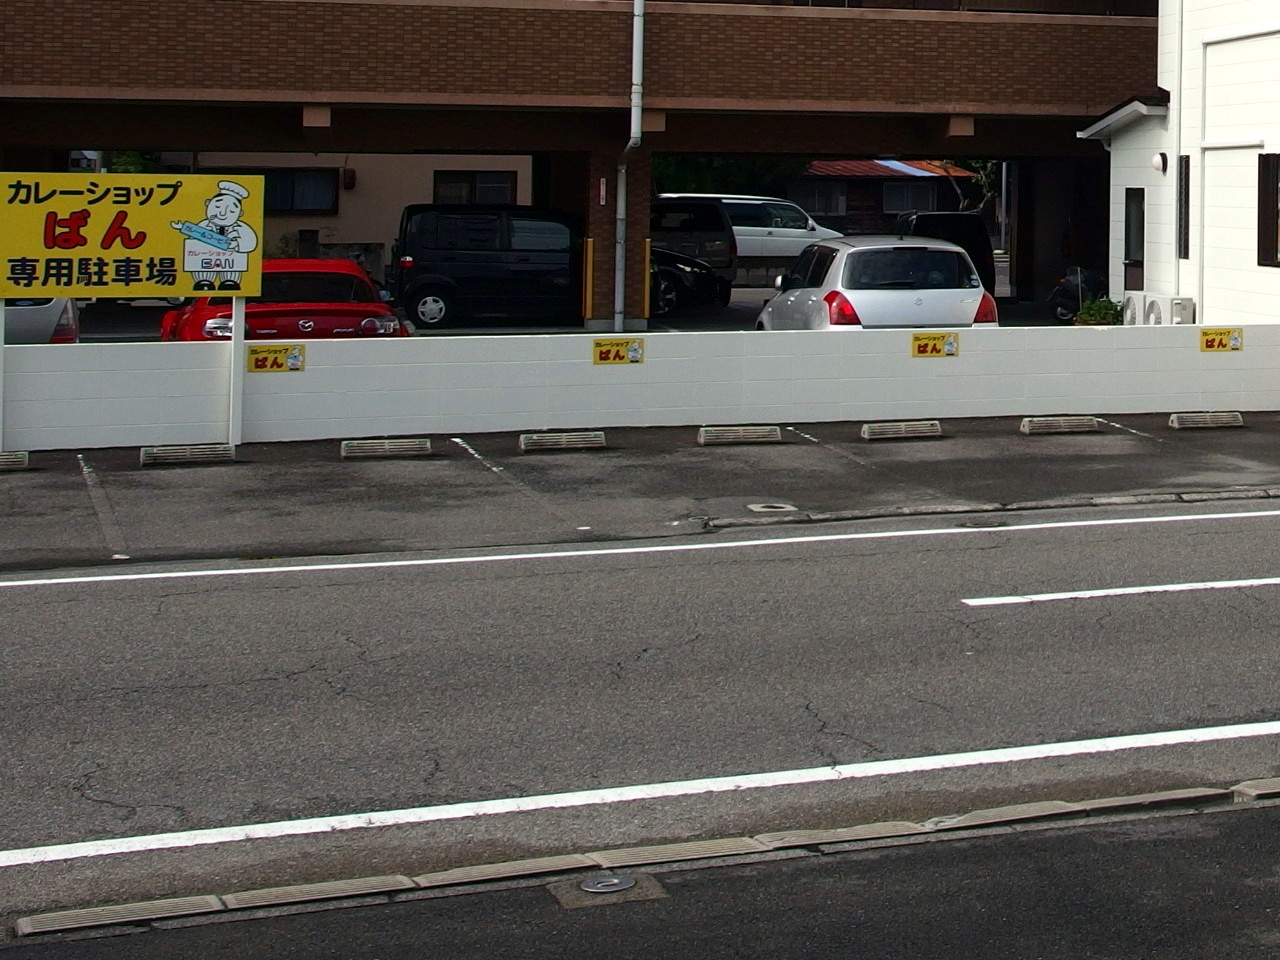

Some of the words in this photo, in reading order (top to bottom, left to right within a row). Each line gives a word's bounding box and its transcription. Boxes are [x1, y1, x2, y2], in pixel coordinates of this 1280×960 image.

[7, 180, 183, 206] カレーショップ
[43, 208, 147, 250] ばん
[6, 256, 178, 288] 専用駐車場
